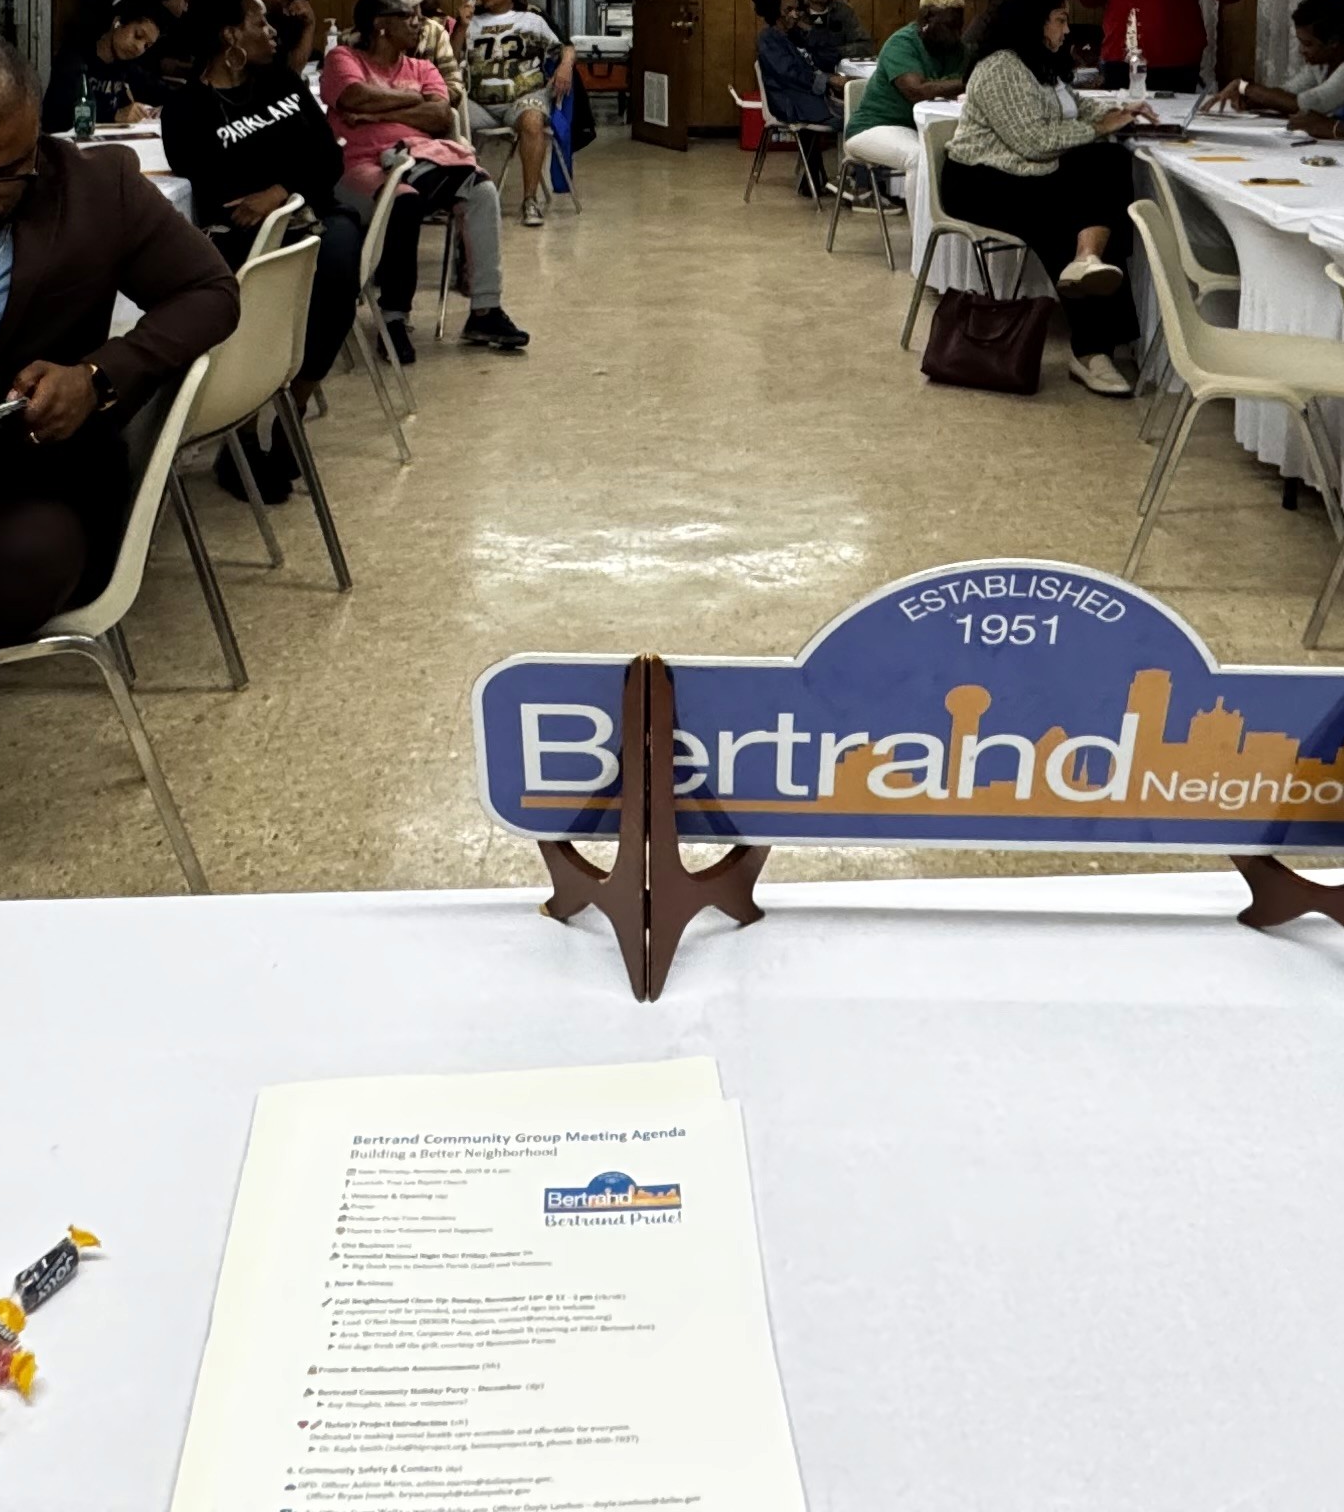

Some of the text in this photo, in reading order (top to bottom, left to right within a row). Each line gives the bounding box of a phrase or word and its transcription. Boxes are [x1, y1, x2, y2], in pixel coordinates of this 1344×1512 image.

[216, 92, 301, 149] PARKLAN
[899, 574, 1127, 622] ESTABLISHED
[956, 614, 1060, 646] 1951
[520, 702, 1140, 802] Bertrand
[352, 1126, 687, 1148] Bertrand Community Group Meeting Agenda
[350, 1149, 406, 1161] Building
[419, 1147, 461, 1159] Better
[464, 1144, 558, 1161] Neighborhood
[547, 1190, 633, 1207] Bertrand
[544, 1213, 626, 1228] Bertrand
